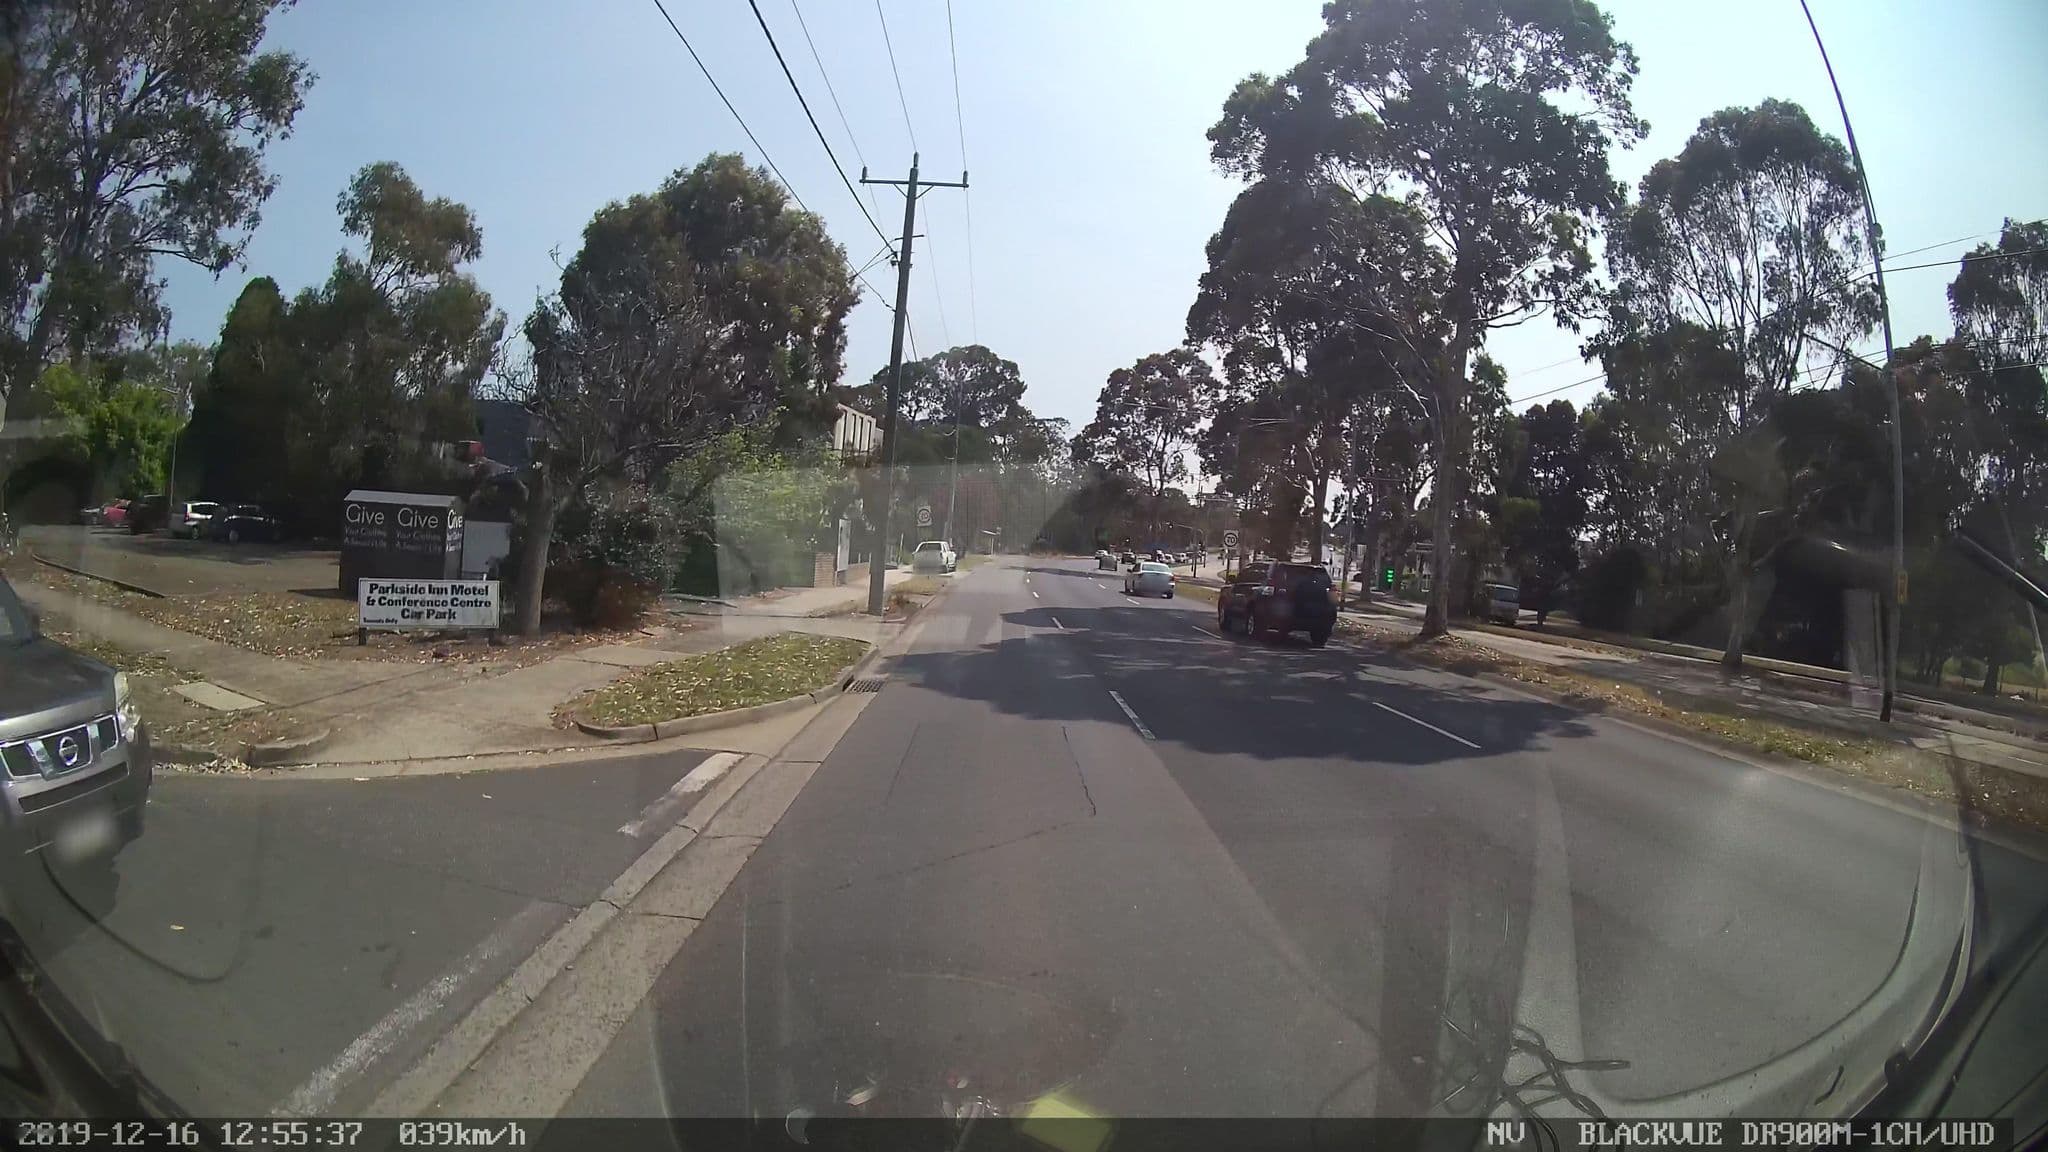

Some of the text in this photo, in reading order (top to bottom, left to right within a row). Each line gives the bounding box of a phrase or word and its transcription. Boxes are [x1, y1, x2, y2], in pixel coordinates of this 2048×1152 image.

[346, 504, 385, 525] Give
[398, 507, 439, 529] Give
[1227, 536, 1235, 544] 70
[369, 583, 489, 596] Parkside Inn Motel
[366, 596, 491, 608] & Conference Centre
[401, 608, 456, 620] Car Park
